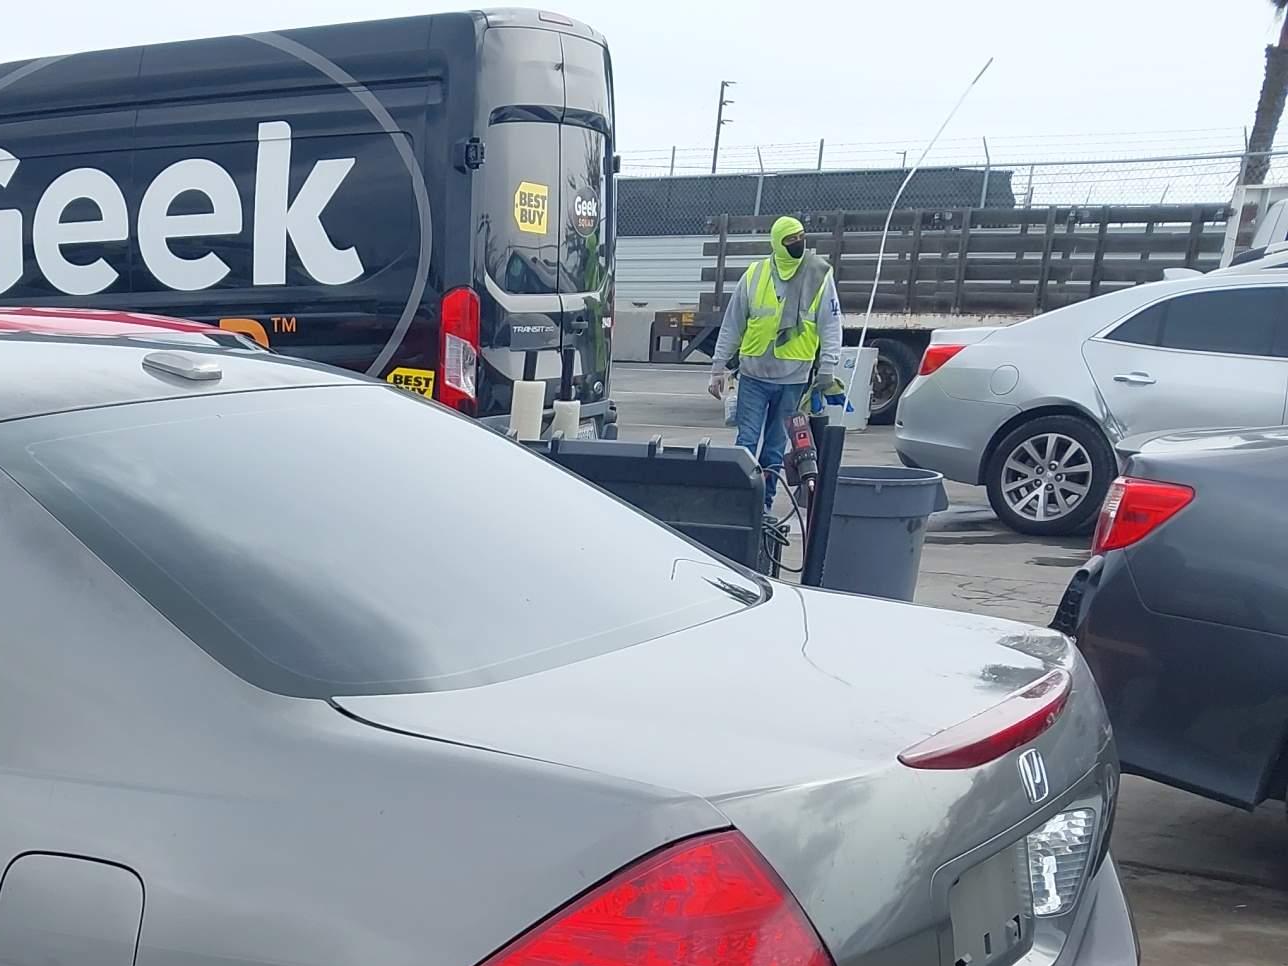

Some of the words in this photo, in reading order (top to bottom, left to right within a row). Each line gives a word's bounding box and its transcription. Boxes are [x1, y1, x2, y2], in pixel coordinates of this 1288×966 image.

[519, 190, 547, 210] BEST
[574, 195, 598, 217] Geek
[520, 208, 545, 226] BUY
[271, 316, 297, 333] TM
[512, 325, 545, 333] TRANSIT
[393, 373, 432, 388] BEST
